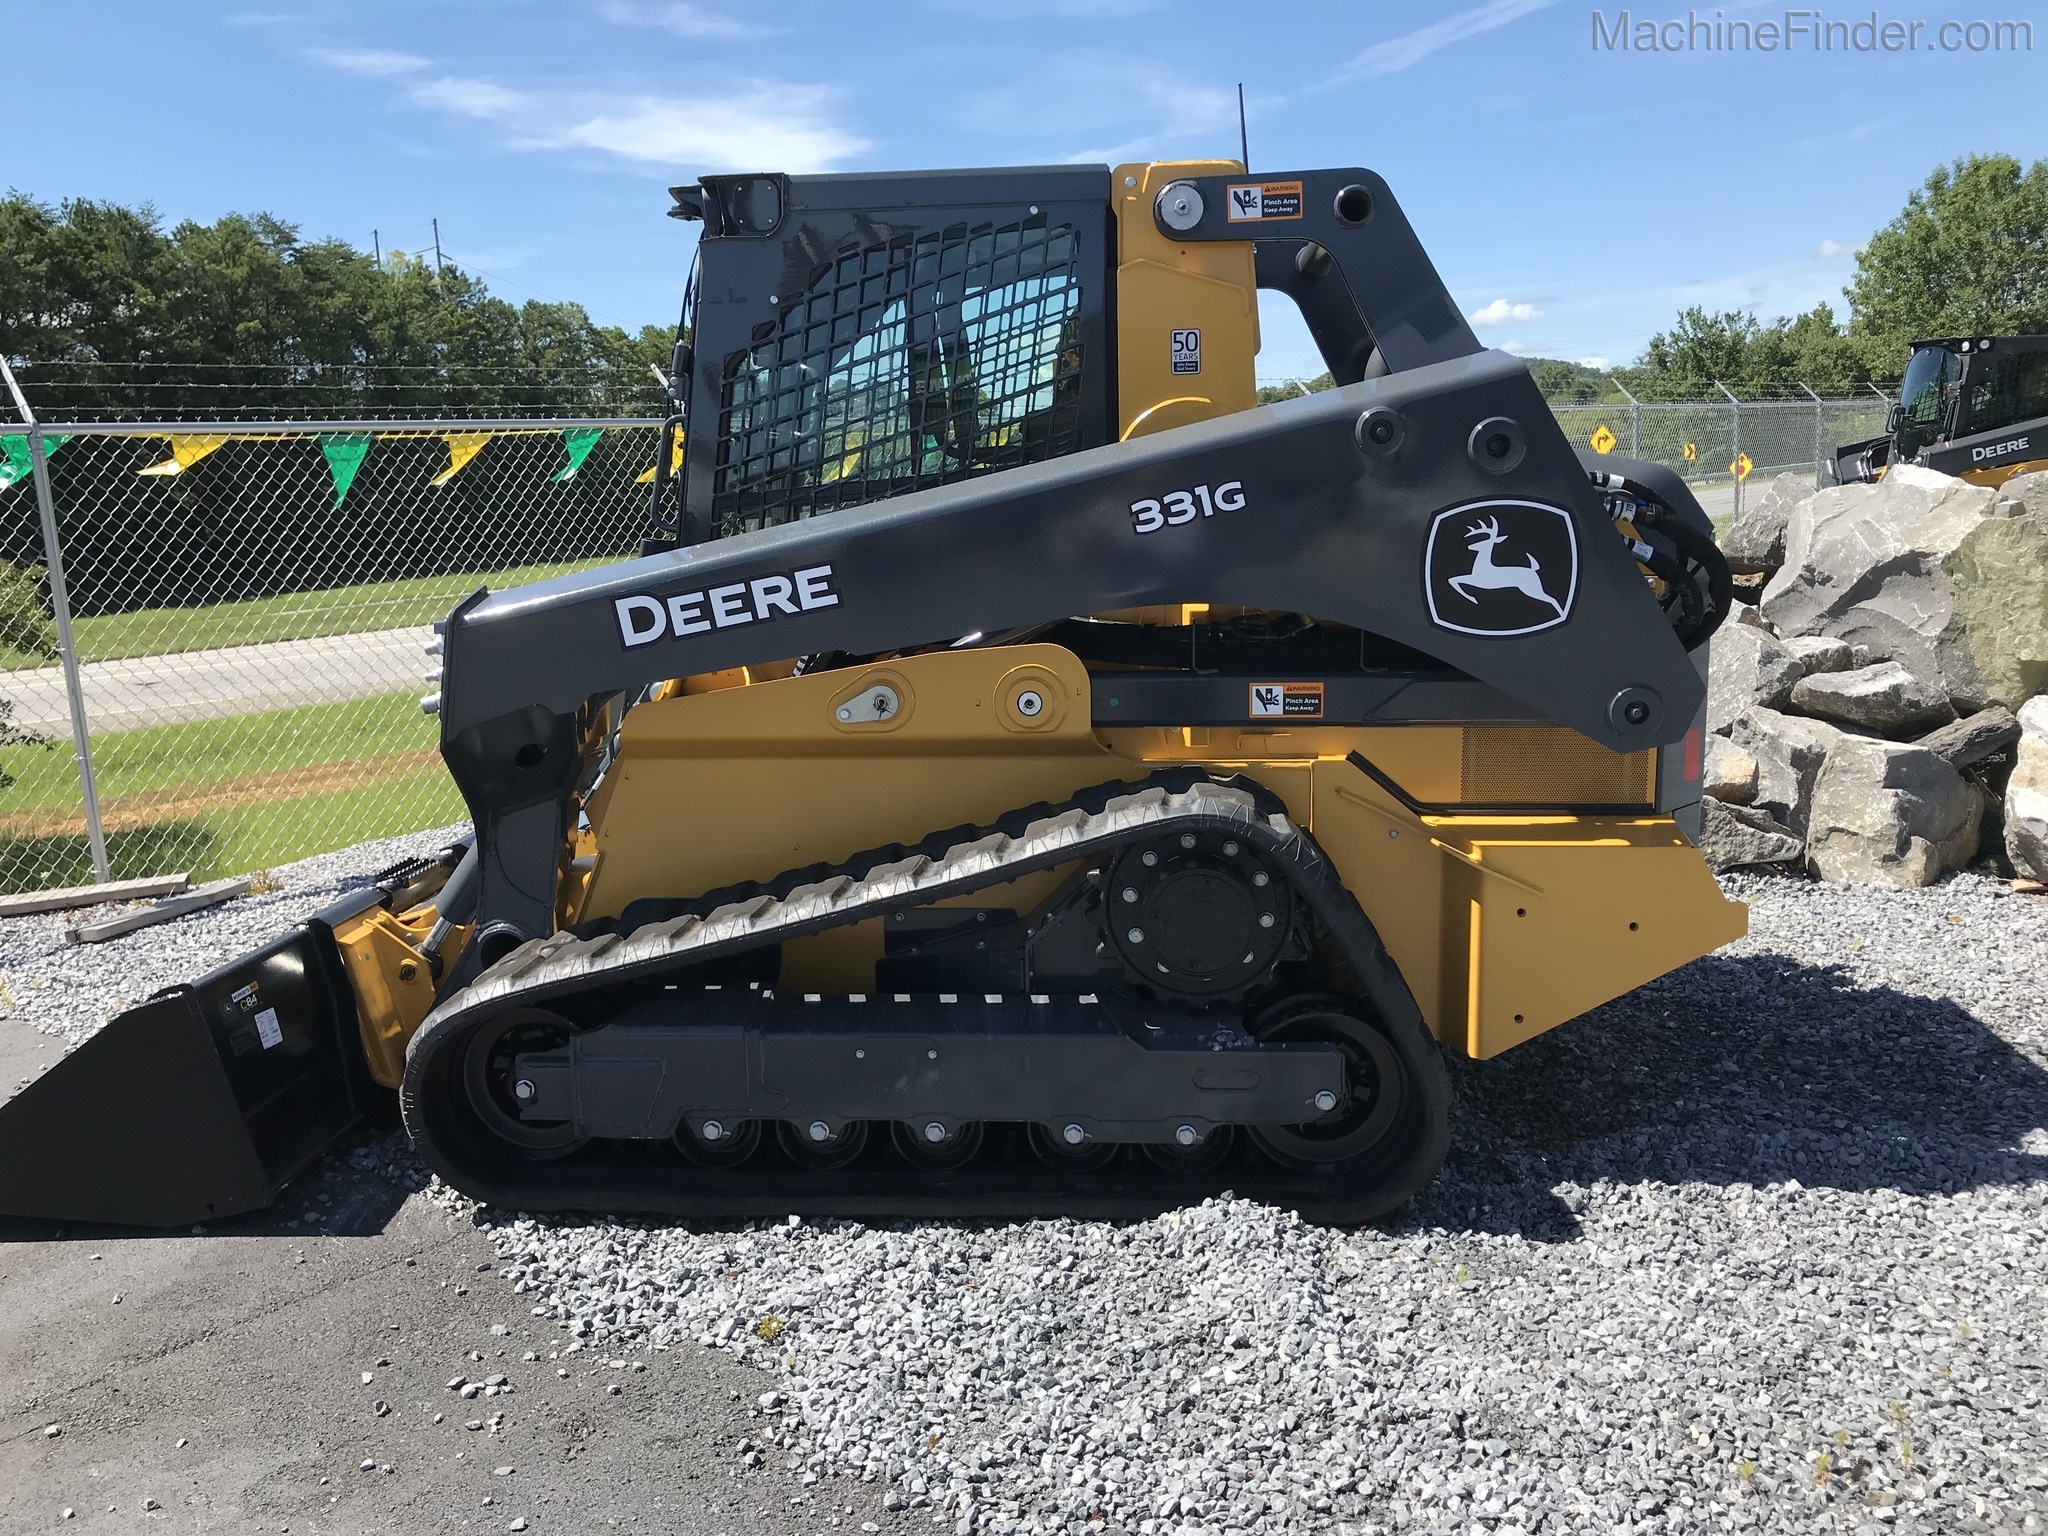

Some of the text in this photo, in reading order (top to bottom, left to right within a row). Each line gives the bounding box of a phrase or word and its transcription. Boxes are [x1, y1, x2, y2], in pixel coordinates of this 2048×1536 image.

[1263, 198, 1282, 206] Pinch
[1173, 331, 1198, 352] 50
[1173, 352, 1198, 360] YEARS
[1972, 437, 2030, 461] DEERE
[1131, 481, 1246, 533] 331G
[615, 564, 839, 647] DEERE
